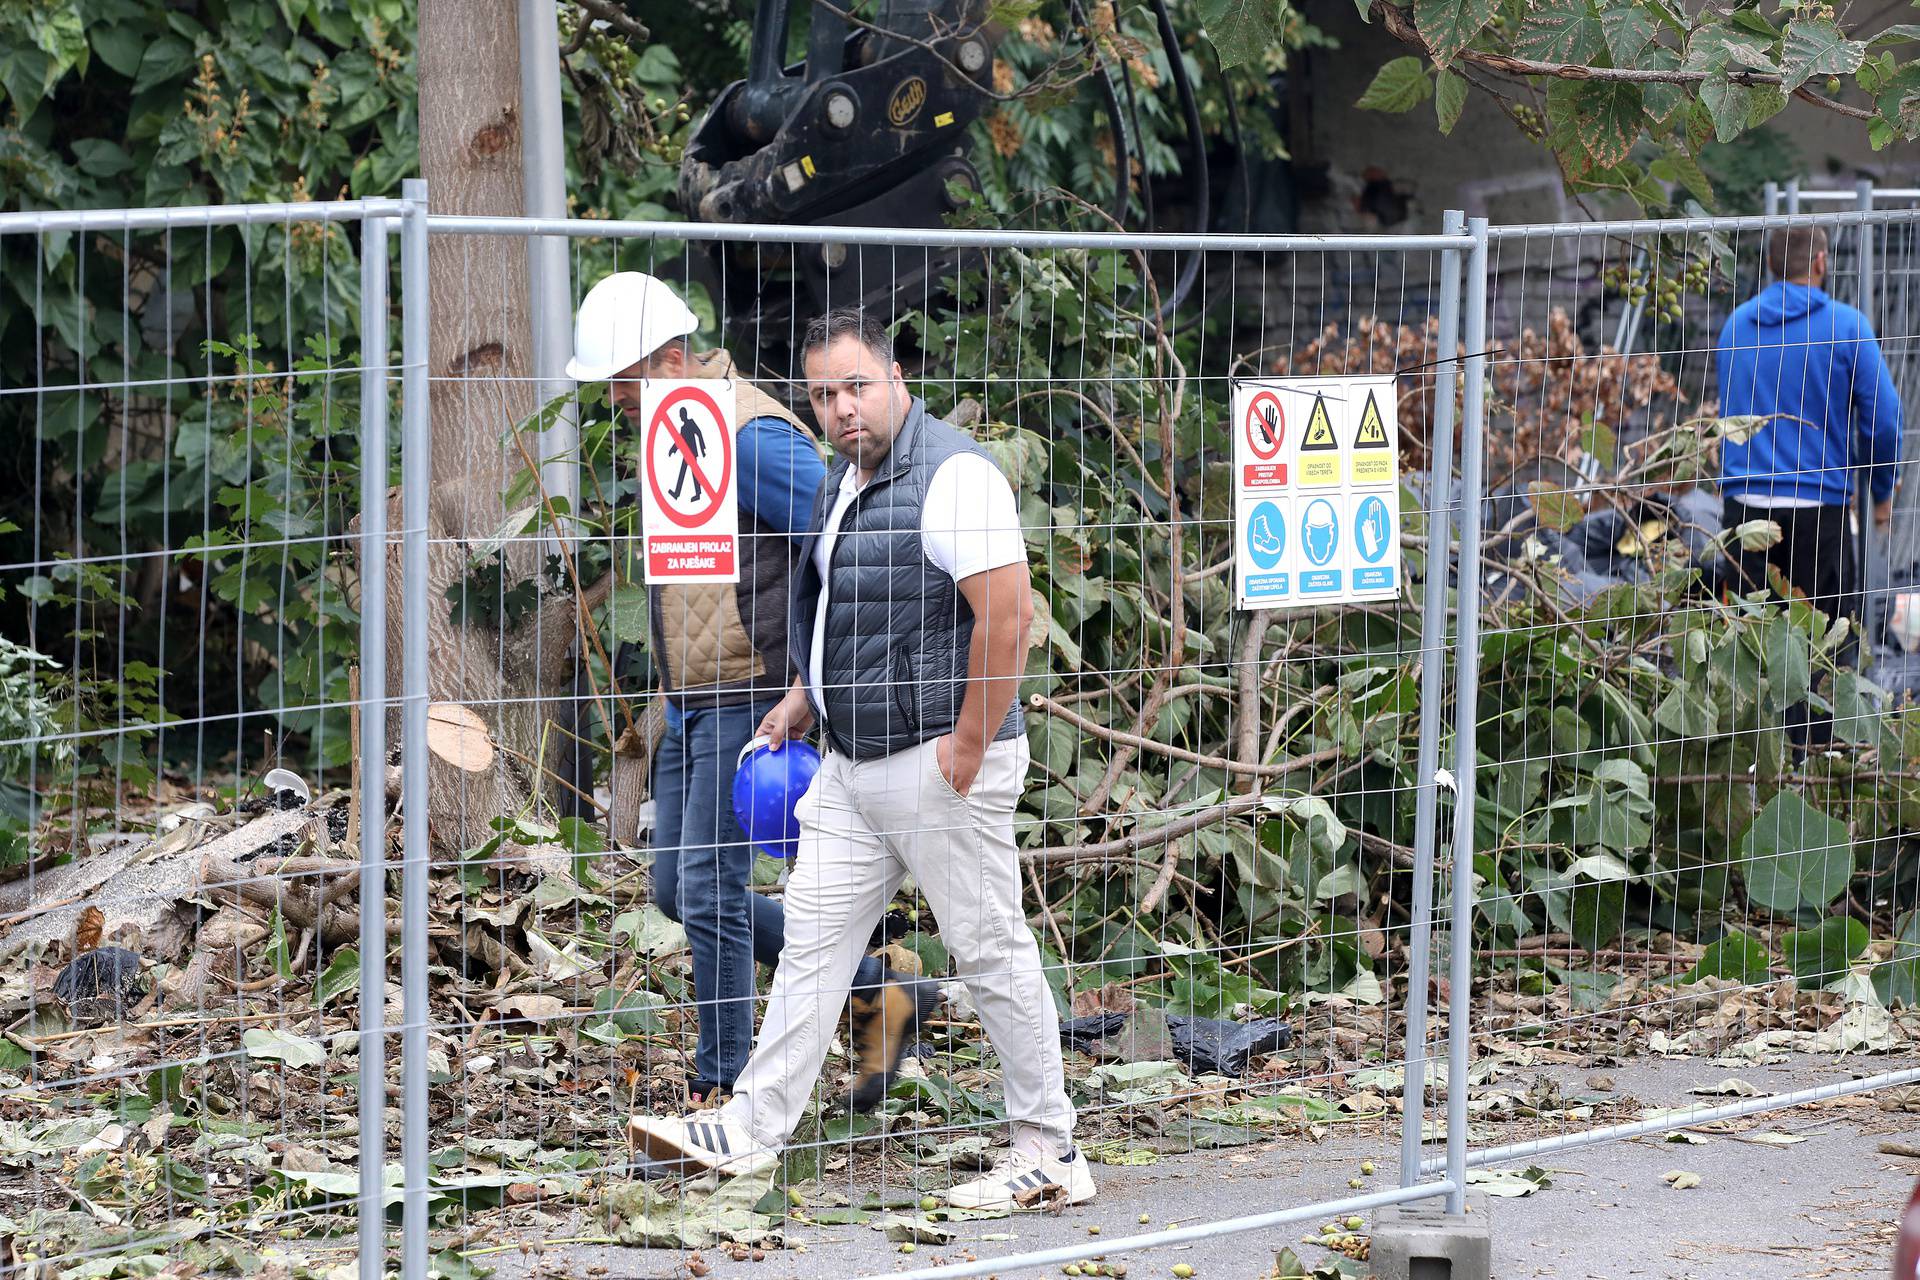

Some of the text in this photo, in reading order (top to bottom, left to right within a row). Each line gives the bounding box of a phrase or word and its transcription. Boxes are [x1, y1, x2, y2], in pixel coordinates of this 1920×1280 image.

[650, 541, 732, 554] ZABRANJEN PROLAZ
[667, 555, 716, 570] ZA PJEŠAKE
